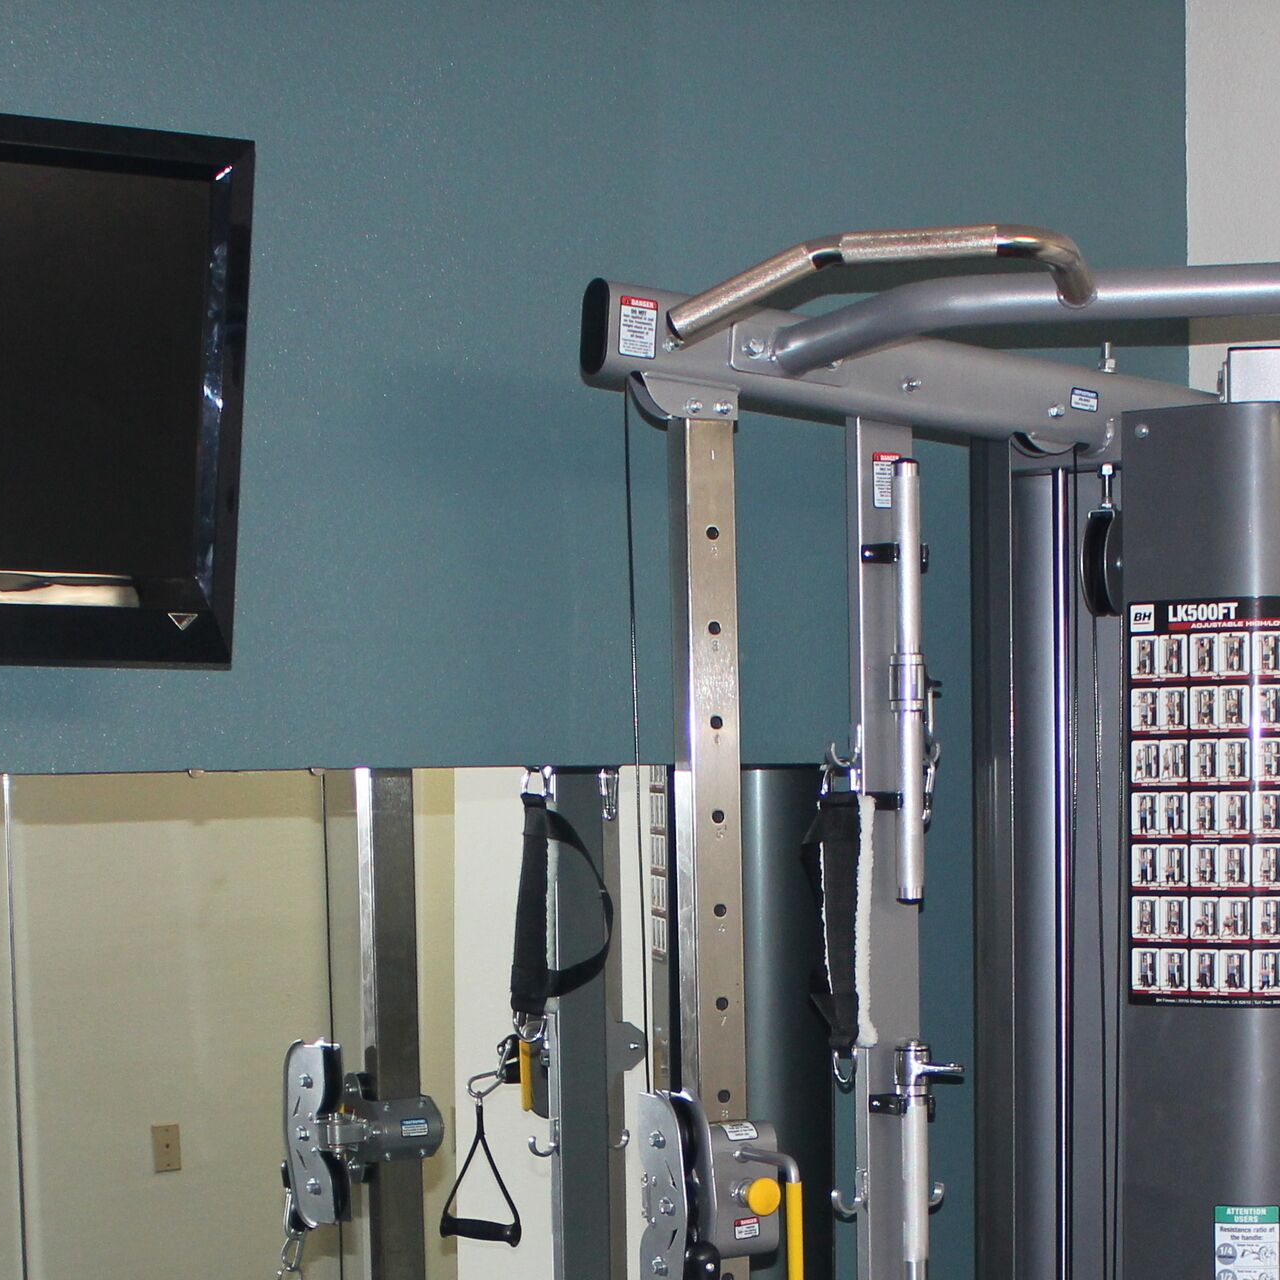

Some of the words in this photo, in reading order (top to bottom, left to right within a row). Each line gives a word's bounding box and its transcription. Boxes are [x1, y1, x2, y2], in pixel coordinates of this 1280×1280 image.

[630, 298, 654, 309] DANGER
[1168, 602, 1239, 623] LK500FT
[1133, 612, 1152, 622] BH
[1190, 621, 1244, 629] ADJUSTABLE
[1226, 1207, 1267, 1215] ATTENTION
[1234, 1215, 1259, 1223] USERS
[1219, 1246, 1233, 1255] 1/4
[1220, 1272, 1233, 1280] 1/2
